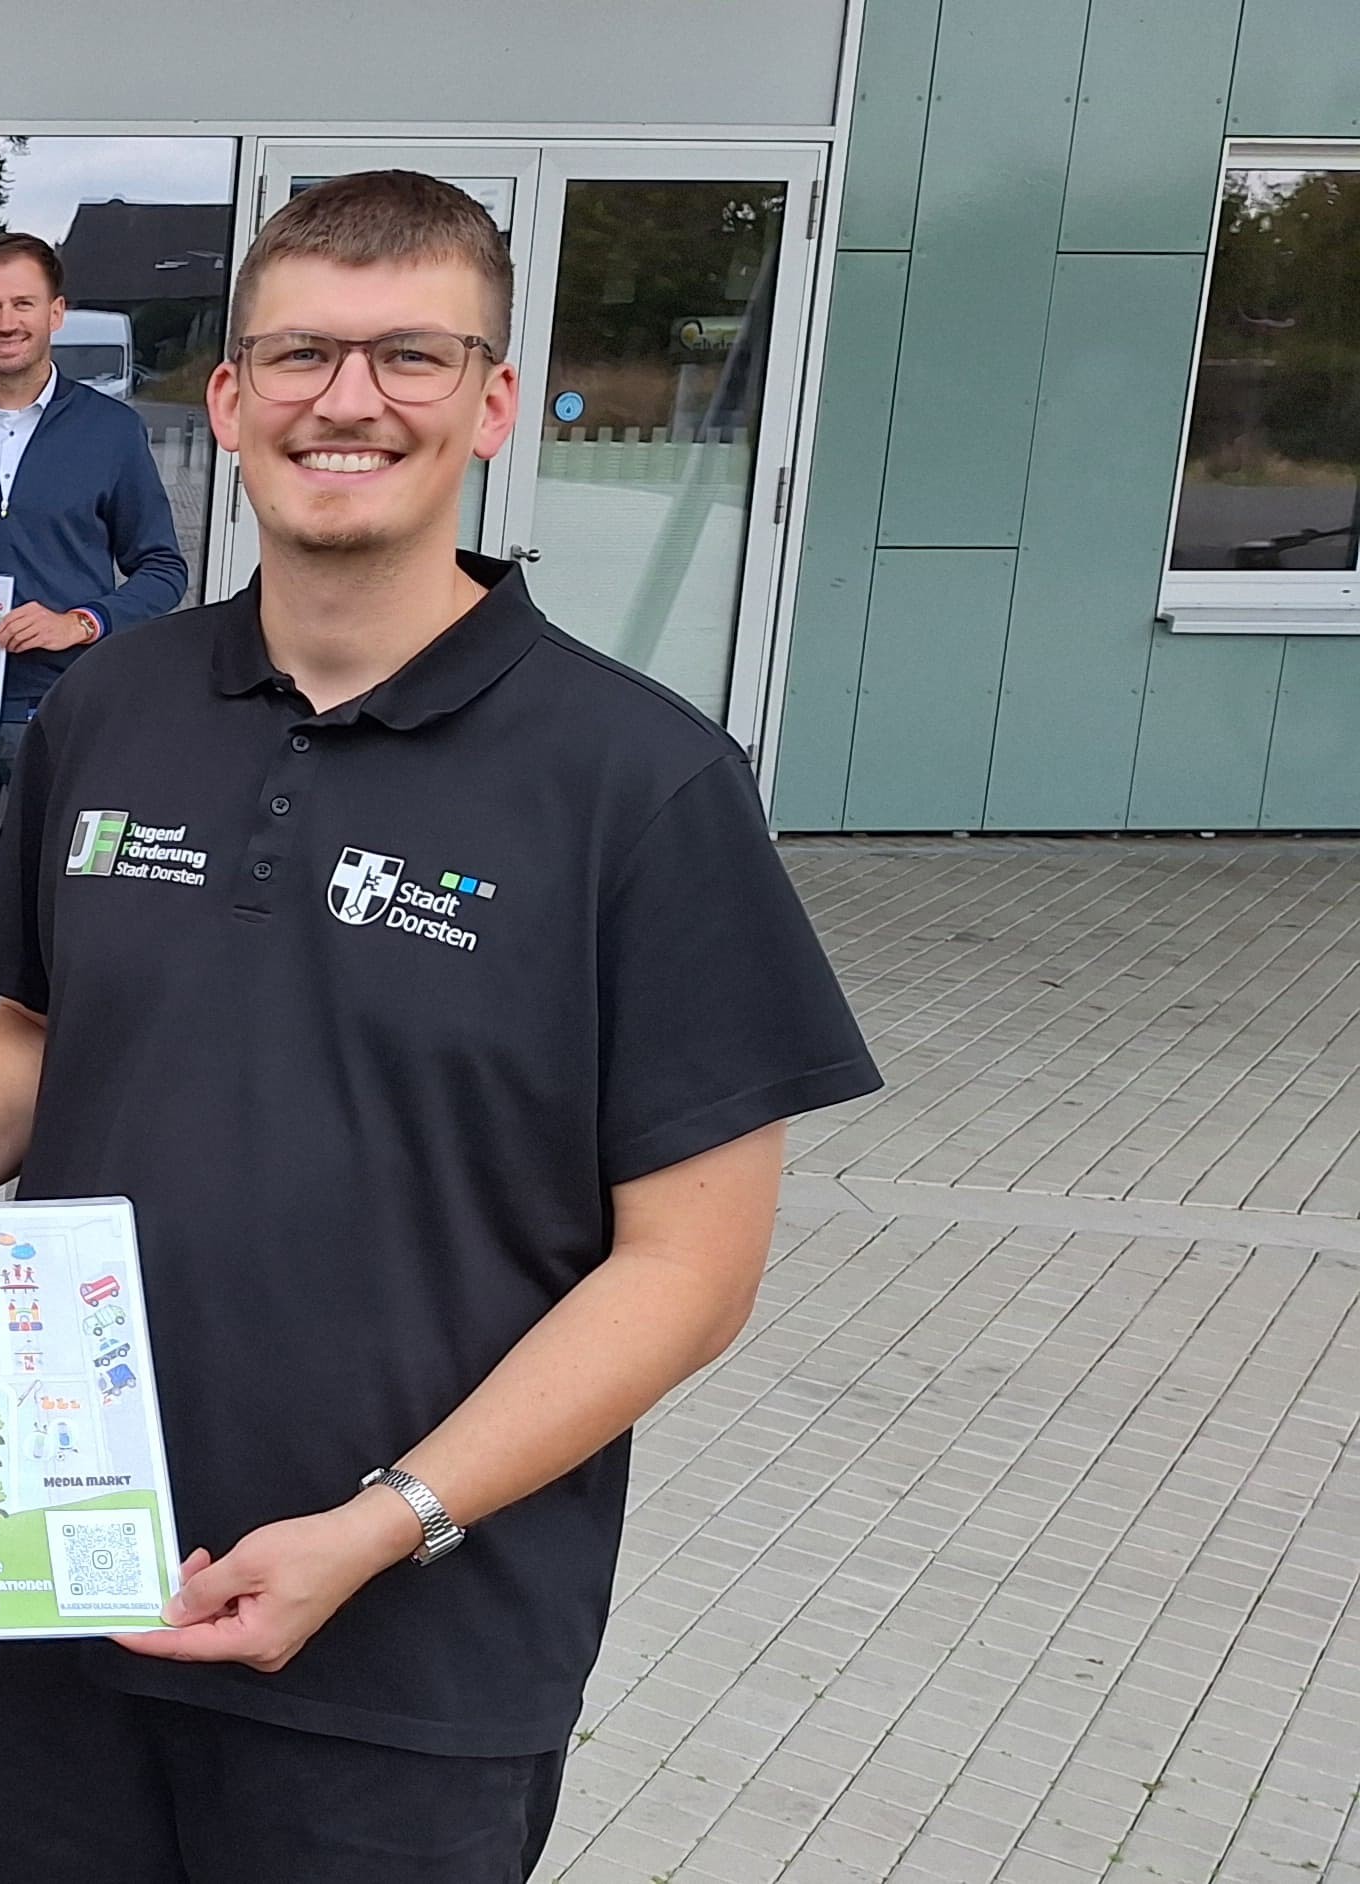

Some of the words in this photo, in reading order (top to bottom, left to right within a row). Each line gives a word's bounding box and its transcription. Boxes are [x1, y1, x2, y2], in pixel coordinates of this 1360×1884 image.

[126, 822, 185, 842] Jugend
[121, 841, 206, 868] Förderung
[115, 862, 148, 879] Stadt
[150, 865, 205, 886] Dorsten
[396, 882, 460, 916] Stadt
[385, 907, 478, 951] Dorsten
